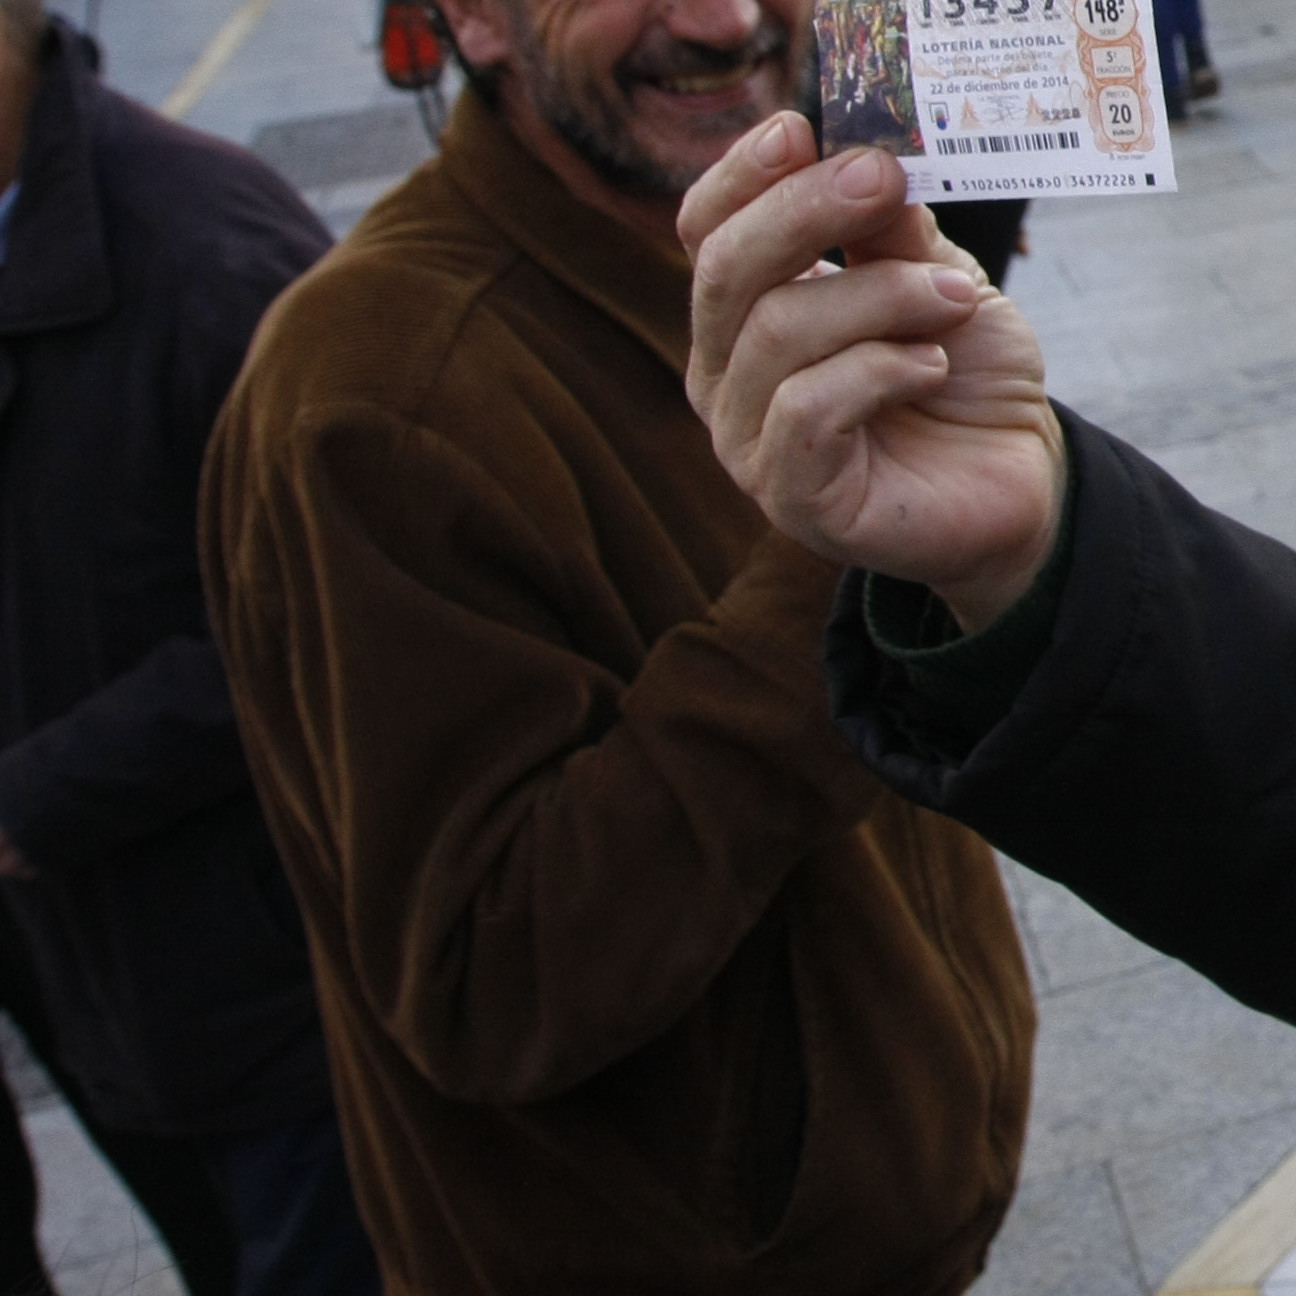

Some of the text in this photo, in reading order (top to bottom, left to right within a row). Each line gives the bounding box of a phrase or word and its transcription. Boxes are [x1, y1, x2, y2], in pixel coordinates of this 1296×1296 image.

[921, 34, 1066, 54] LOTERÍA NACIONAL
[931, 75, 1070, 95] 22 de diciembre de 2014
[1109, 104, 1132, 124] 20
